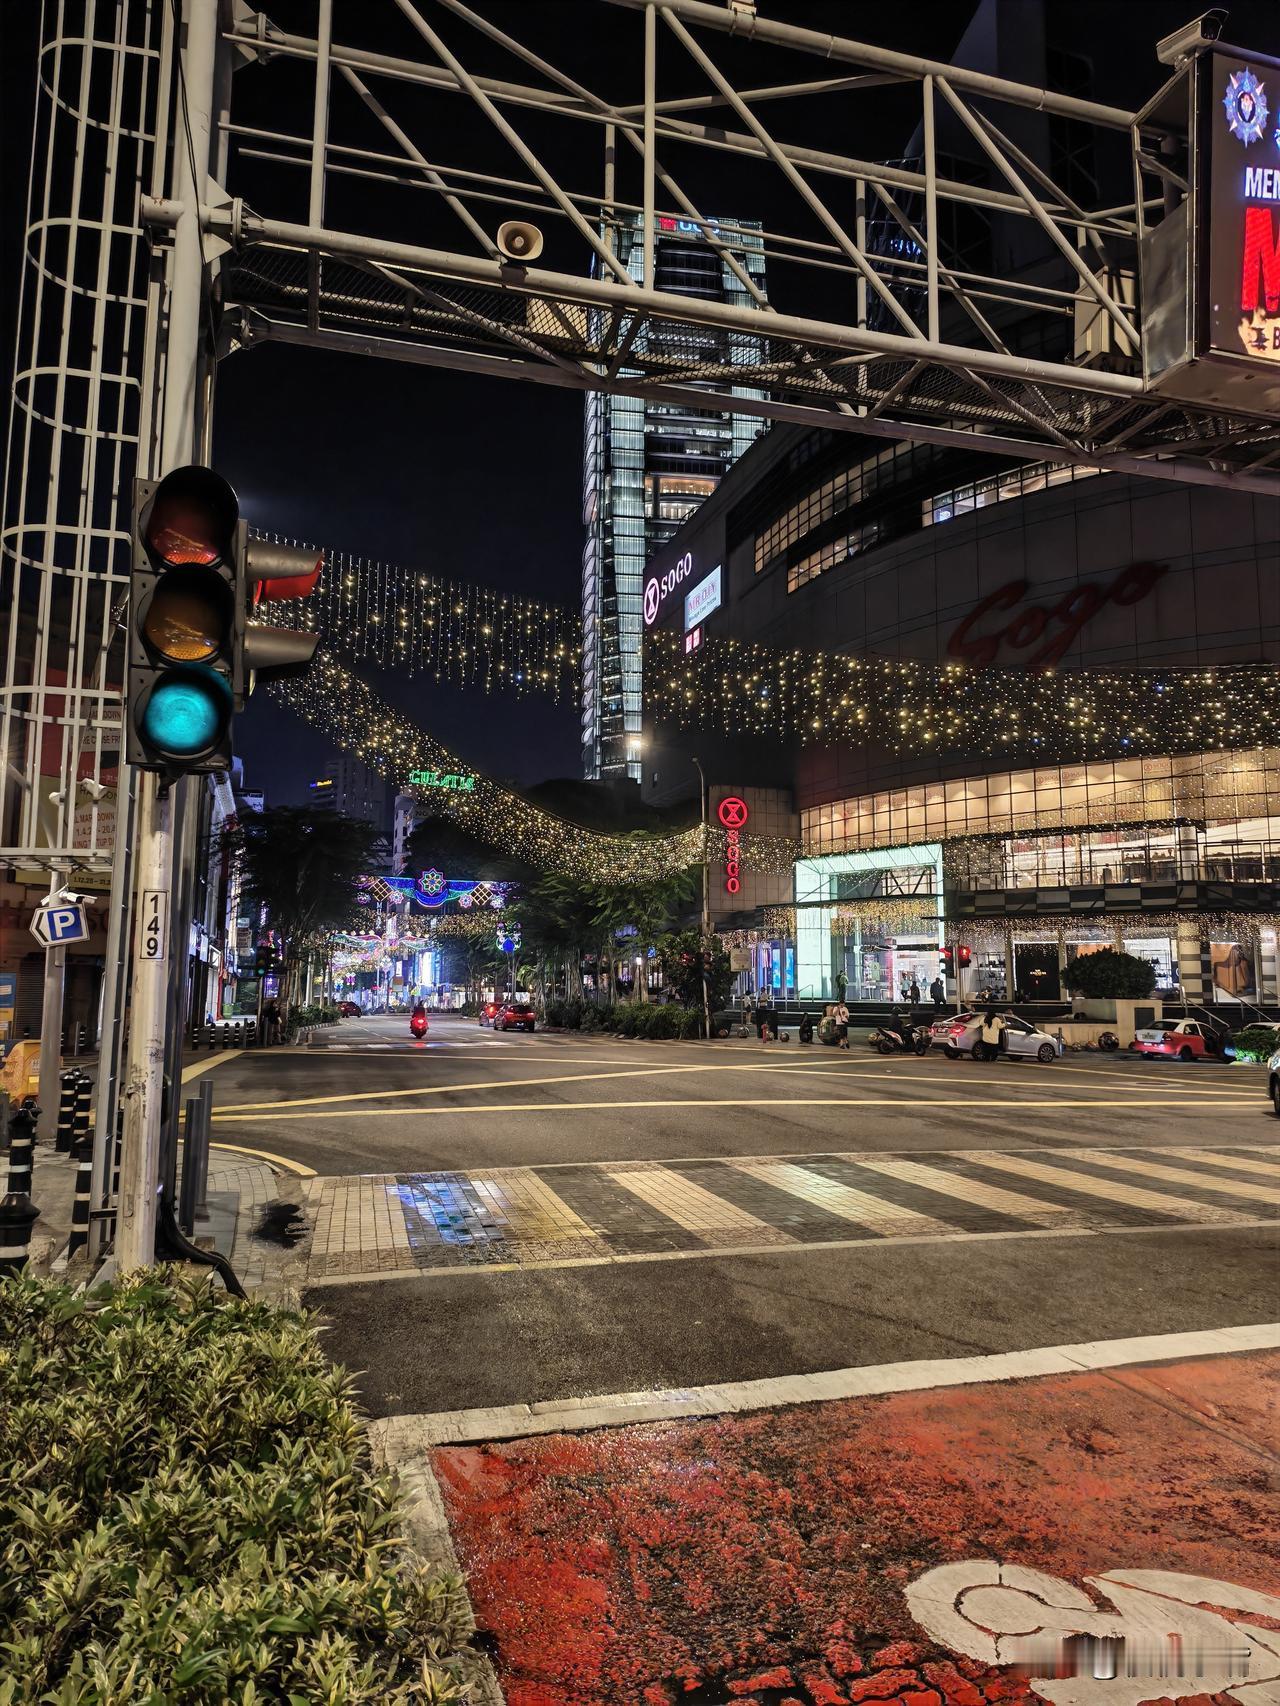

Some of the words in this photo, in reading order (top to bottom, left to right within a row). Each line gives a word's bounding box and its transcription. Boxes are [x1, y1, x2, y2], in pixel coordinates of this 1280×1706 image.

[660, 552, 692, 600] SOGO
[79, 812, 115, 823] MARDOWN
[726, 829, 740, 893] SOGO
[53, 911, 75, 938] P
[146, 894, 160, 957] 149
